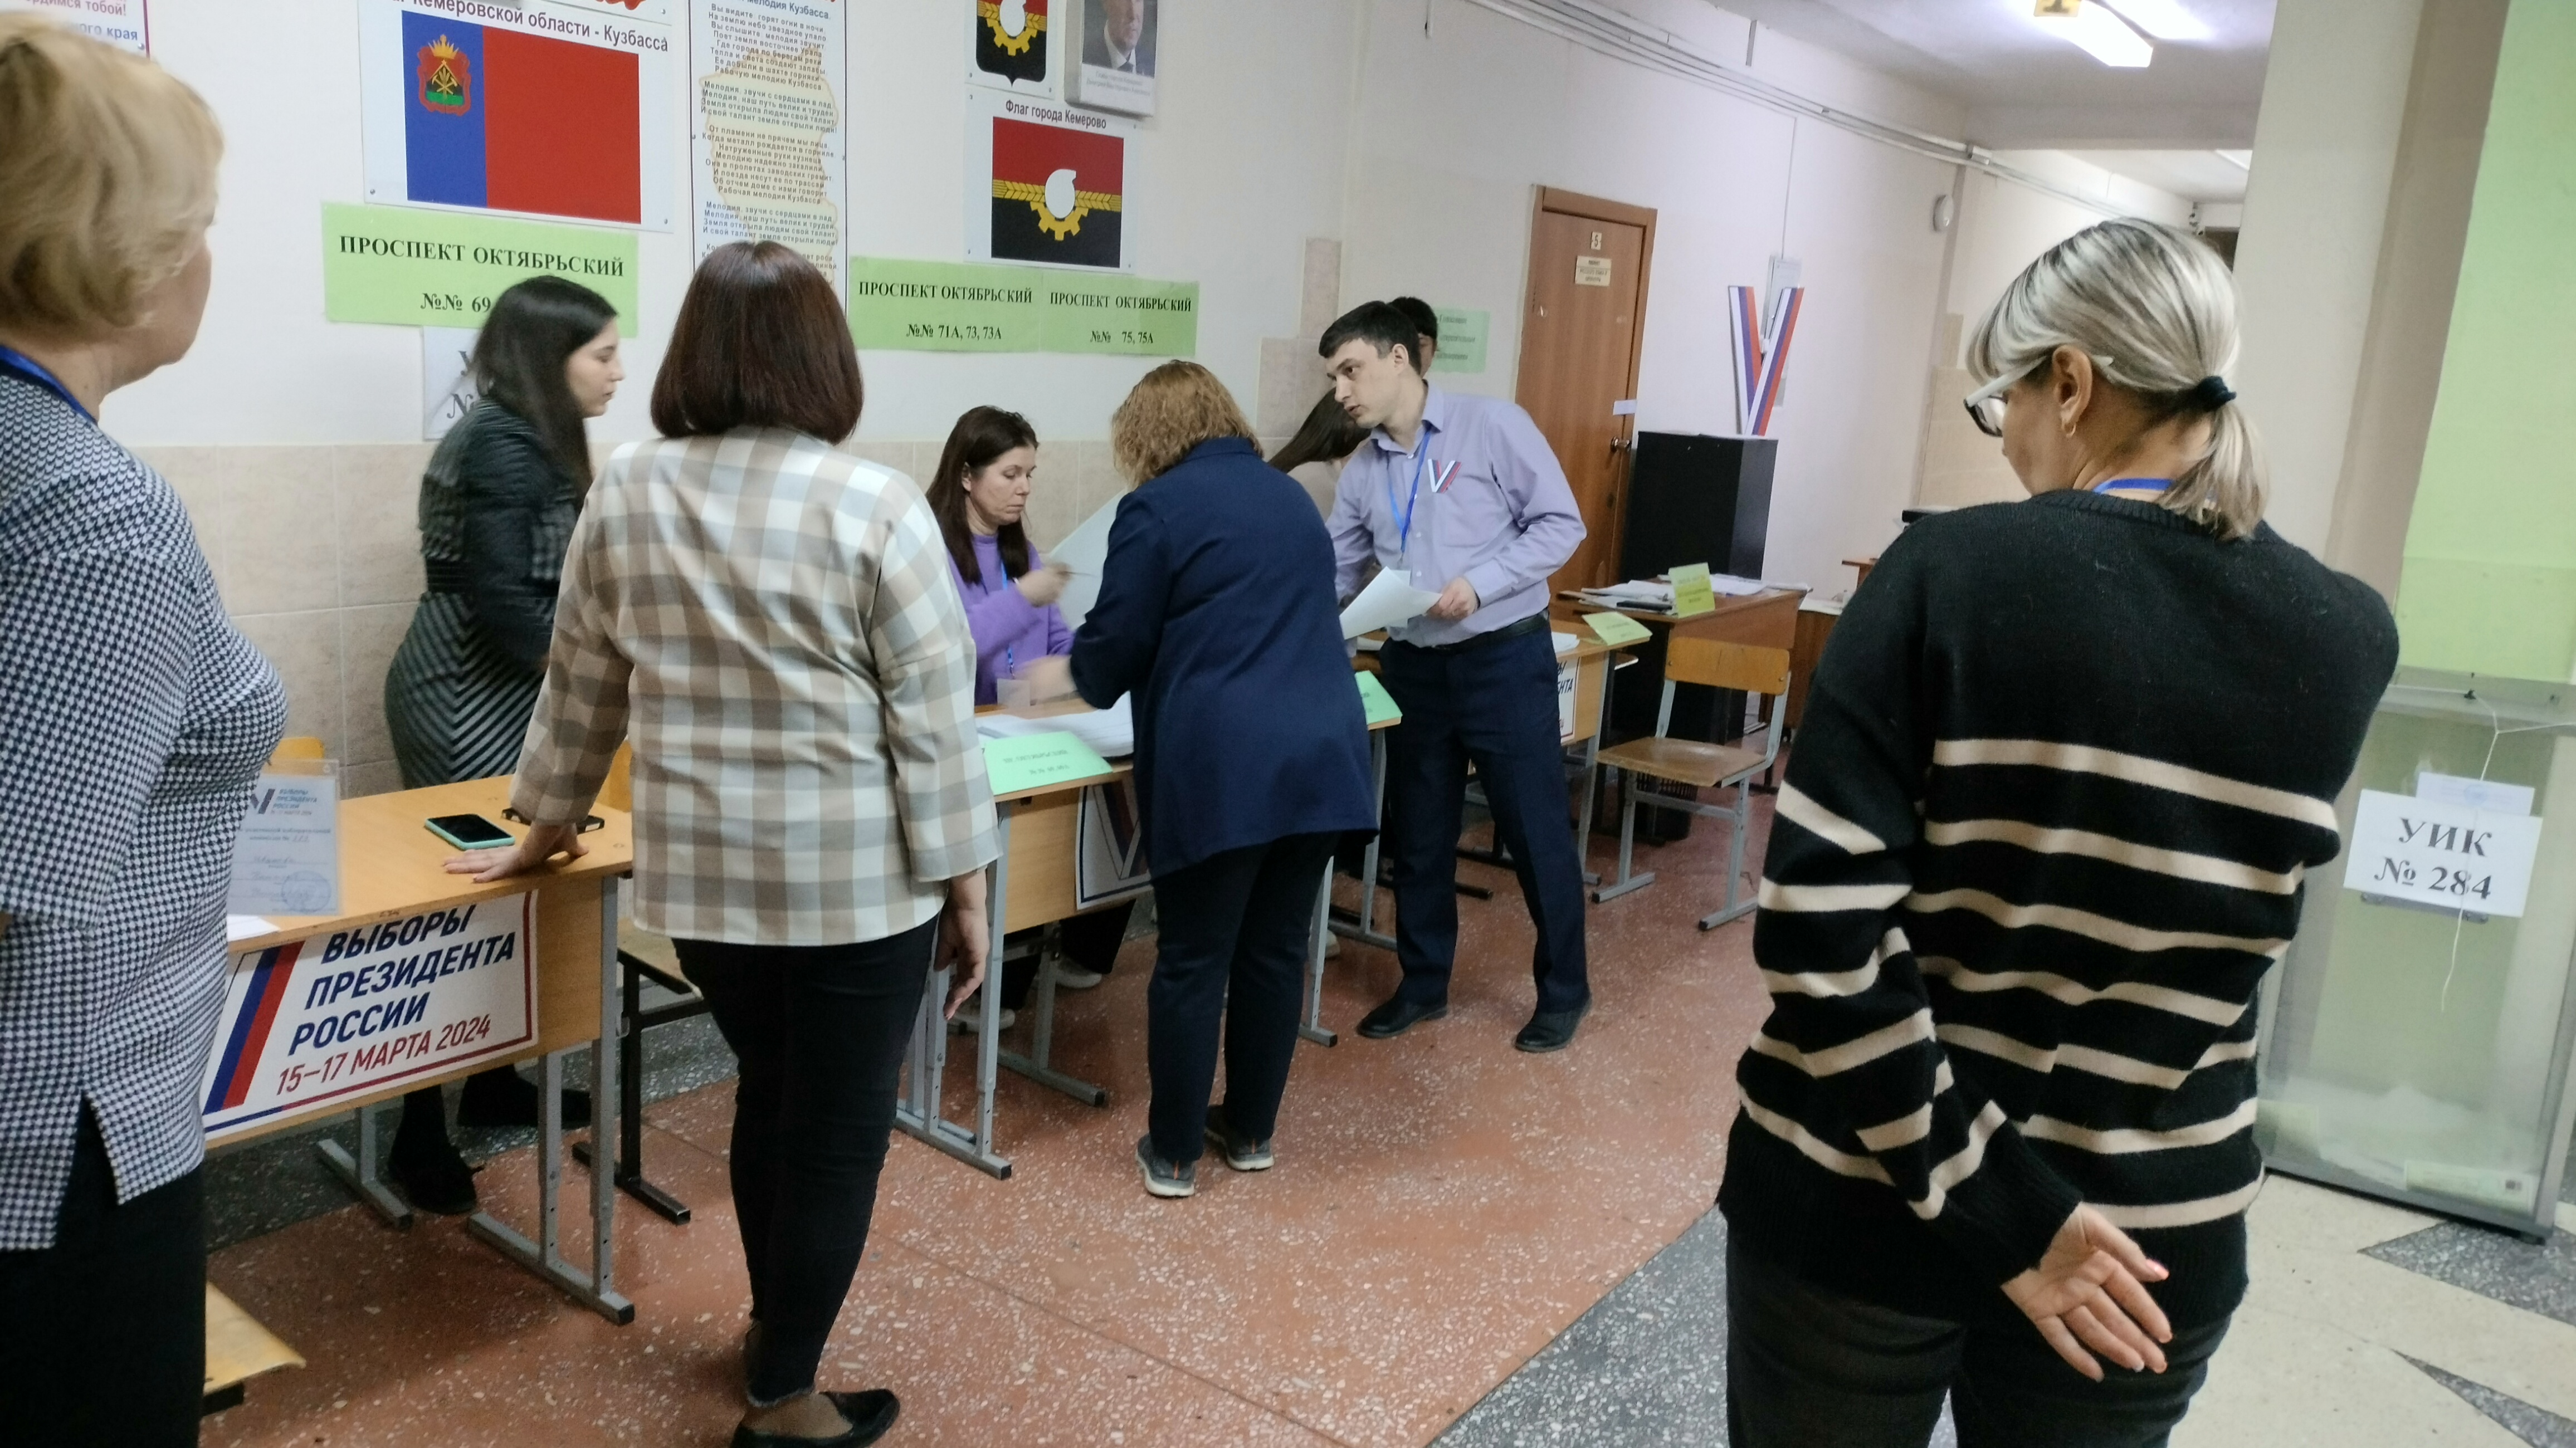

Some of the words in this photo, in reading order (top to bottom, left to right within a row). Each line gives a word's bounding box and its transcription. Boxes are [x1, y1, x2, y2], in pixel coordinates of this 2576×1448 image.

[86, 1, 126, 16] тобой!
[107, 27, 138, 40] края
[528, 12, 590, 37] области
[604, 25, 669, 52] Кузбасса
[1006, 100, 1030, 116] Флаг
[1031, 105, 1062, 124] города
[1065, 109, 1106, 129] Кемерово
[340, 235, 465, 262] ПРОСПЕКТ
[473, 246, 625, 277] ОКТЯБРЬСКИЙ
[858, 281, 937, 299] ПРОСПЕКТ
[941, 285, 1032, 304] ОКТЯБРЬСКИЙ
[1050, 292, 1110, 309] ПРОСПЕКТ
[1115, 293, 1192, 312] ОКТЯБРЬСКИЙ
[2399, 818, 2492, 857] УИК
[2429, 867, 2493, 900] 284
[321, 904, 476, 965] ВЫБОРЫ
[304, 932, 516, 1010] ПРЕЗИДЕНТА
[288, 992, 430, 1056] РОССИИ
[349, 1030, 432, 1075] МАРТА
[436, 1014, 490, 1050] 2024
